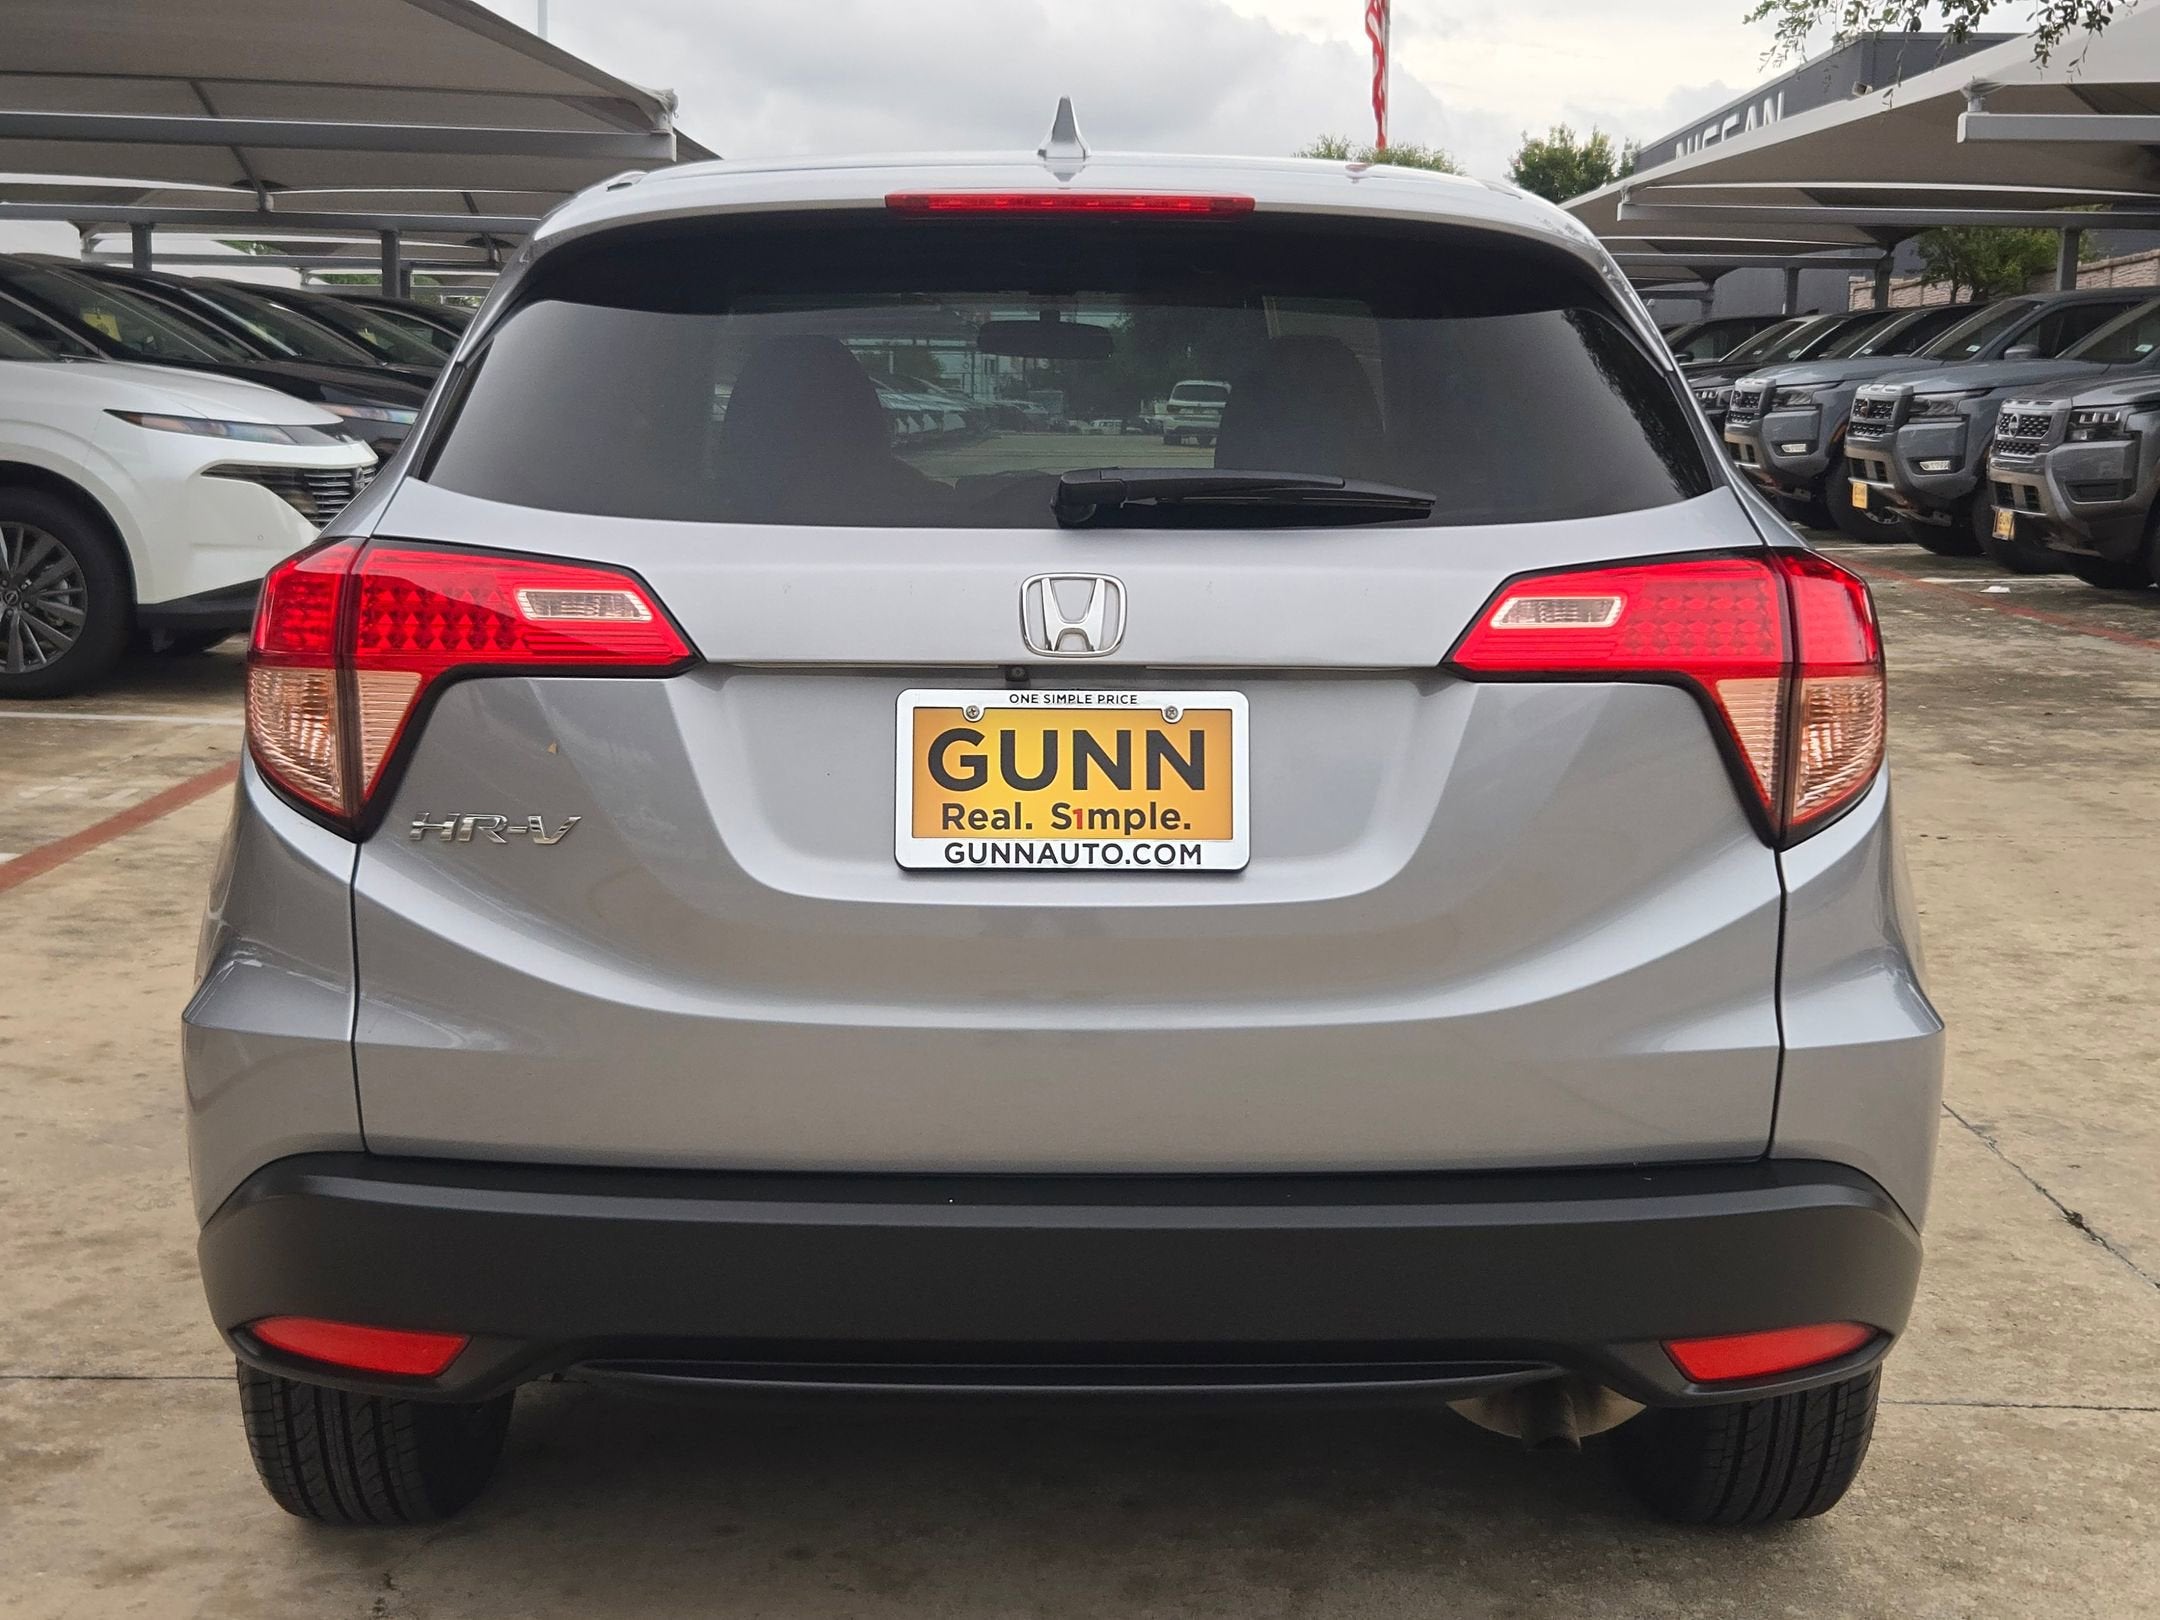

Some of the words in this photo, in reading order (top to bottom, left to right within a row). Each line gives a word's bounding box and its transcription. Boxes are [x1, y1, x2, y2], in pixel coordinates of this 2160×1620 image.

[1009, 693, 1039, 705] ONE
[1043, 693, 1092, 705] SIMPLE
[1097, 694, 1138, 705] PRICE
[928, 727, 1206, 793] GUNN
[409, 811, 583, 846] HR-V
[942, 801, 1033, 831] Real.
[944, 842, 1202, 866] GUNNAUTO.COM
